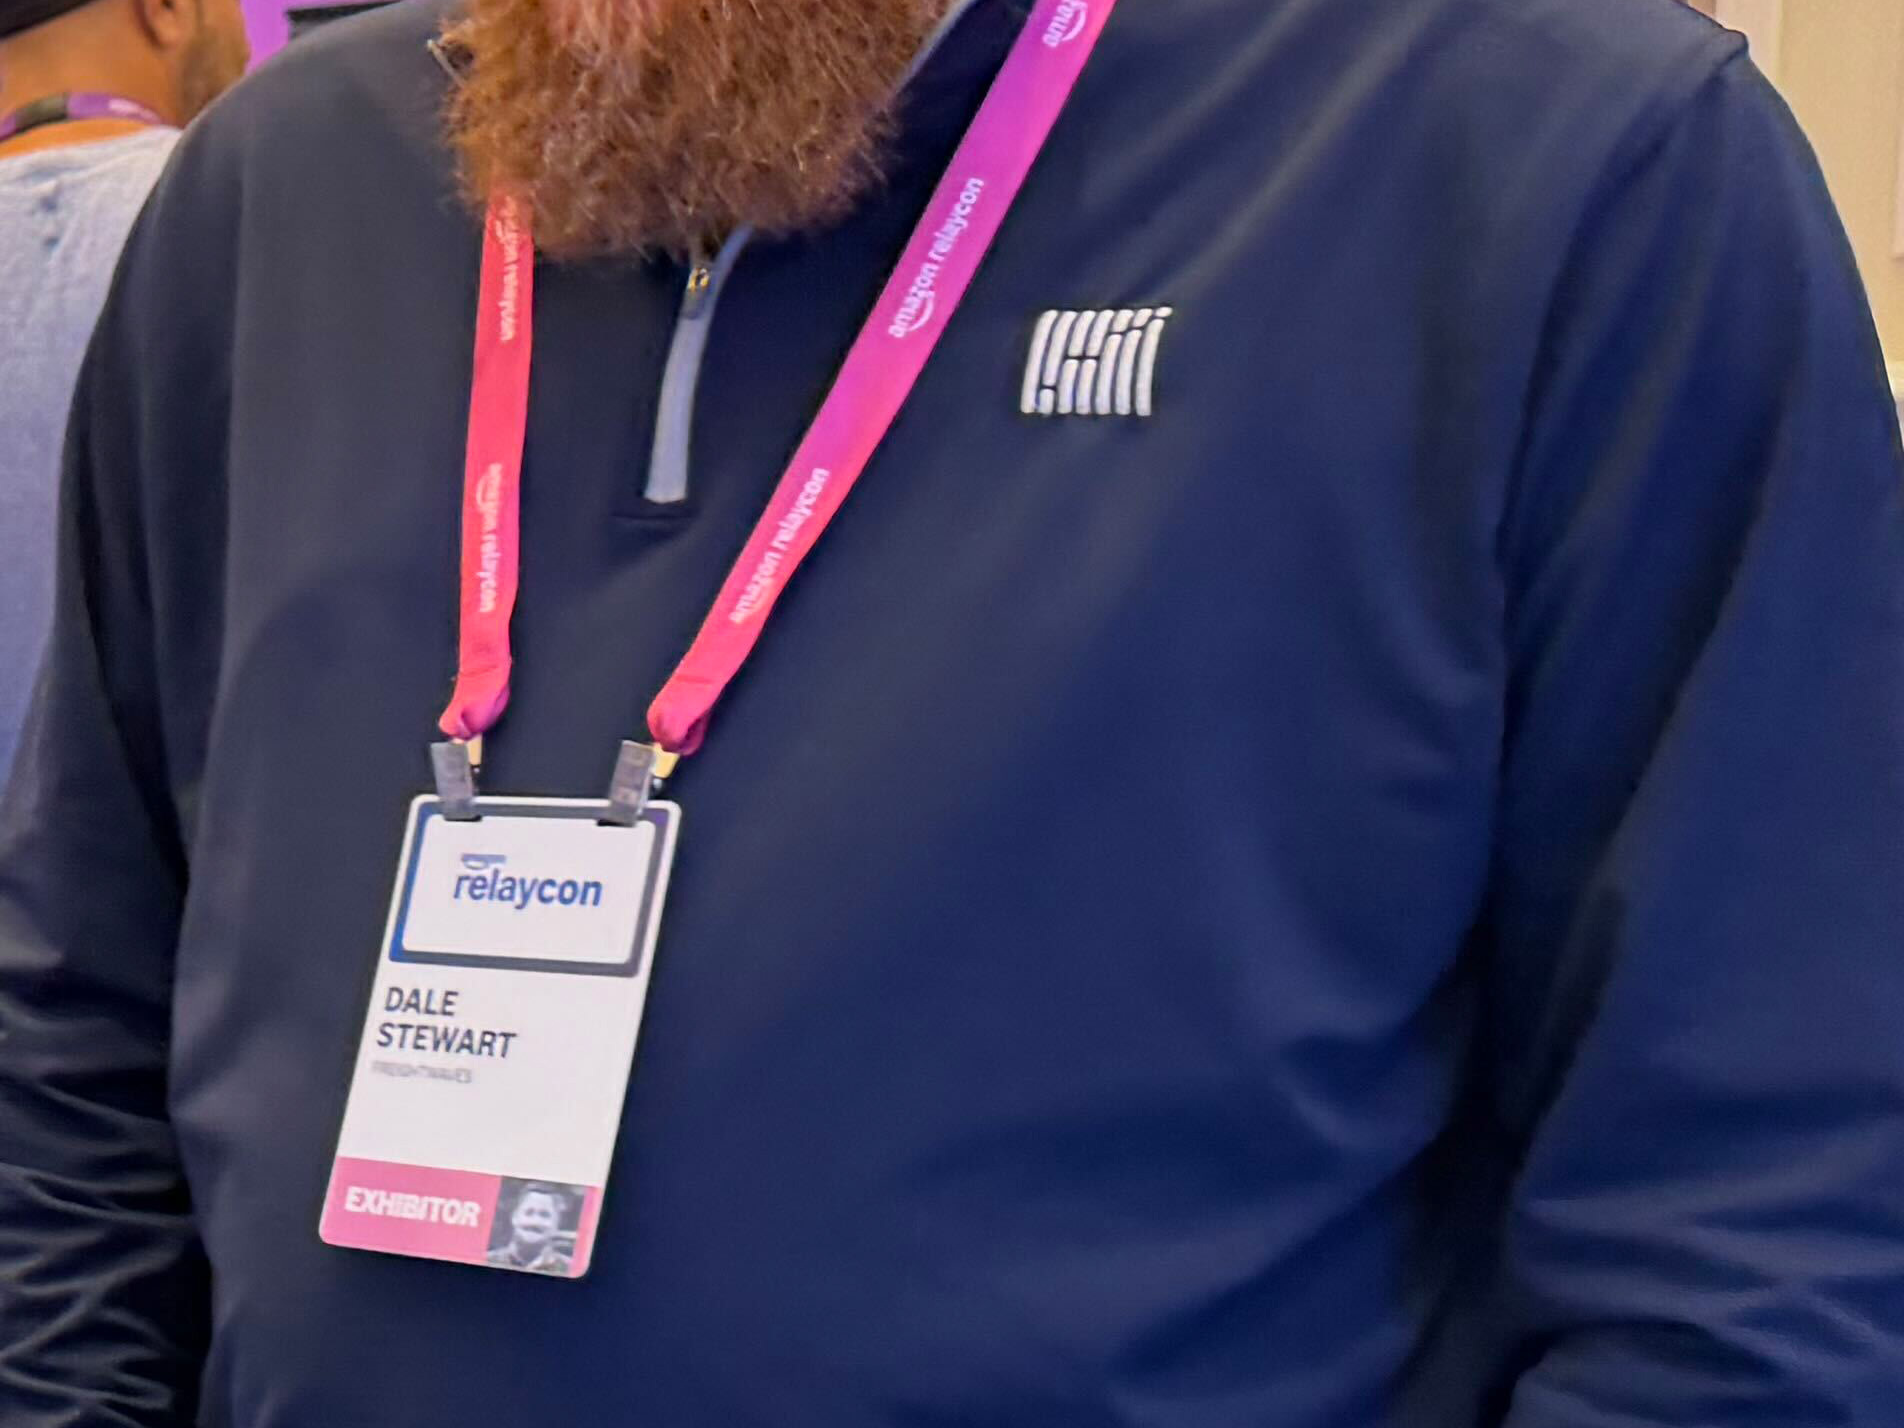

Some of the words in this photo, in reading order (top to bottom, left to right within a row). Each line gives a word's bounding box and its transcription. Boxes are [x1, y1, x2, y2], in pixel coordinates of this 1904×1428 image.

[888, 262, 941, 339] amazon
[928, 177, 985, 261] relaycon
[770, 467, 831, 551] relaycon
[453, 868, 603, 910] relaycon
[384, 986, 459, 1016] DALE
[376, 1022, 517, 1058] STEWART
[344, 1185, 482, 1229] EXHIBITOR
